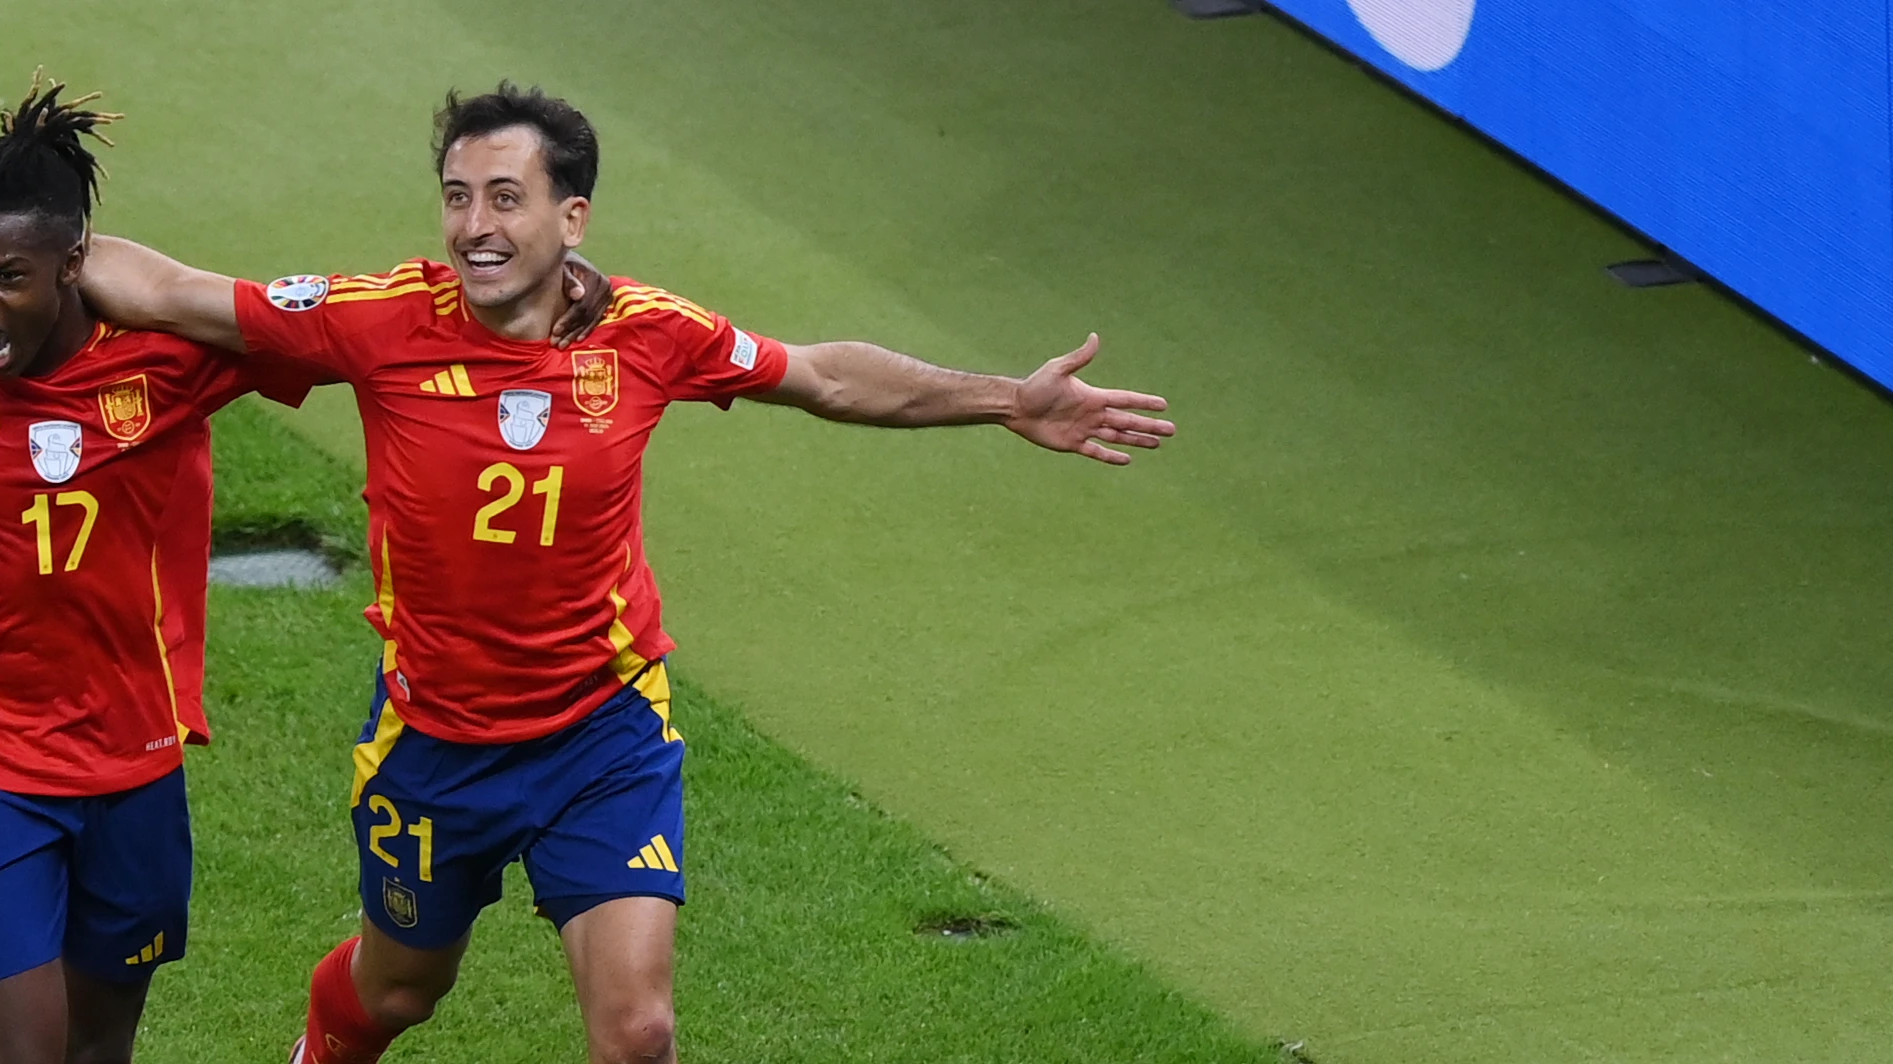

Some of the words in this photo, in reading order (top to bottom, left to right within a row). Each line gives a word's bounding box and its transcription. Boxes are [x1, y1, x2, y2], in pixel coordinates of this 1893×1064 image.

[22, 490, 99, 575] 17
[473, 462, 563, 546] 21
[369, 794, 433, 882] 21
